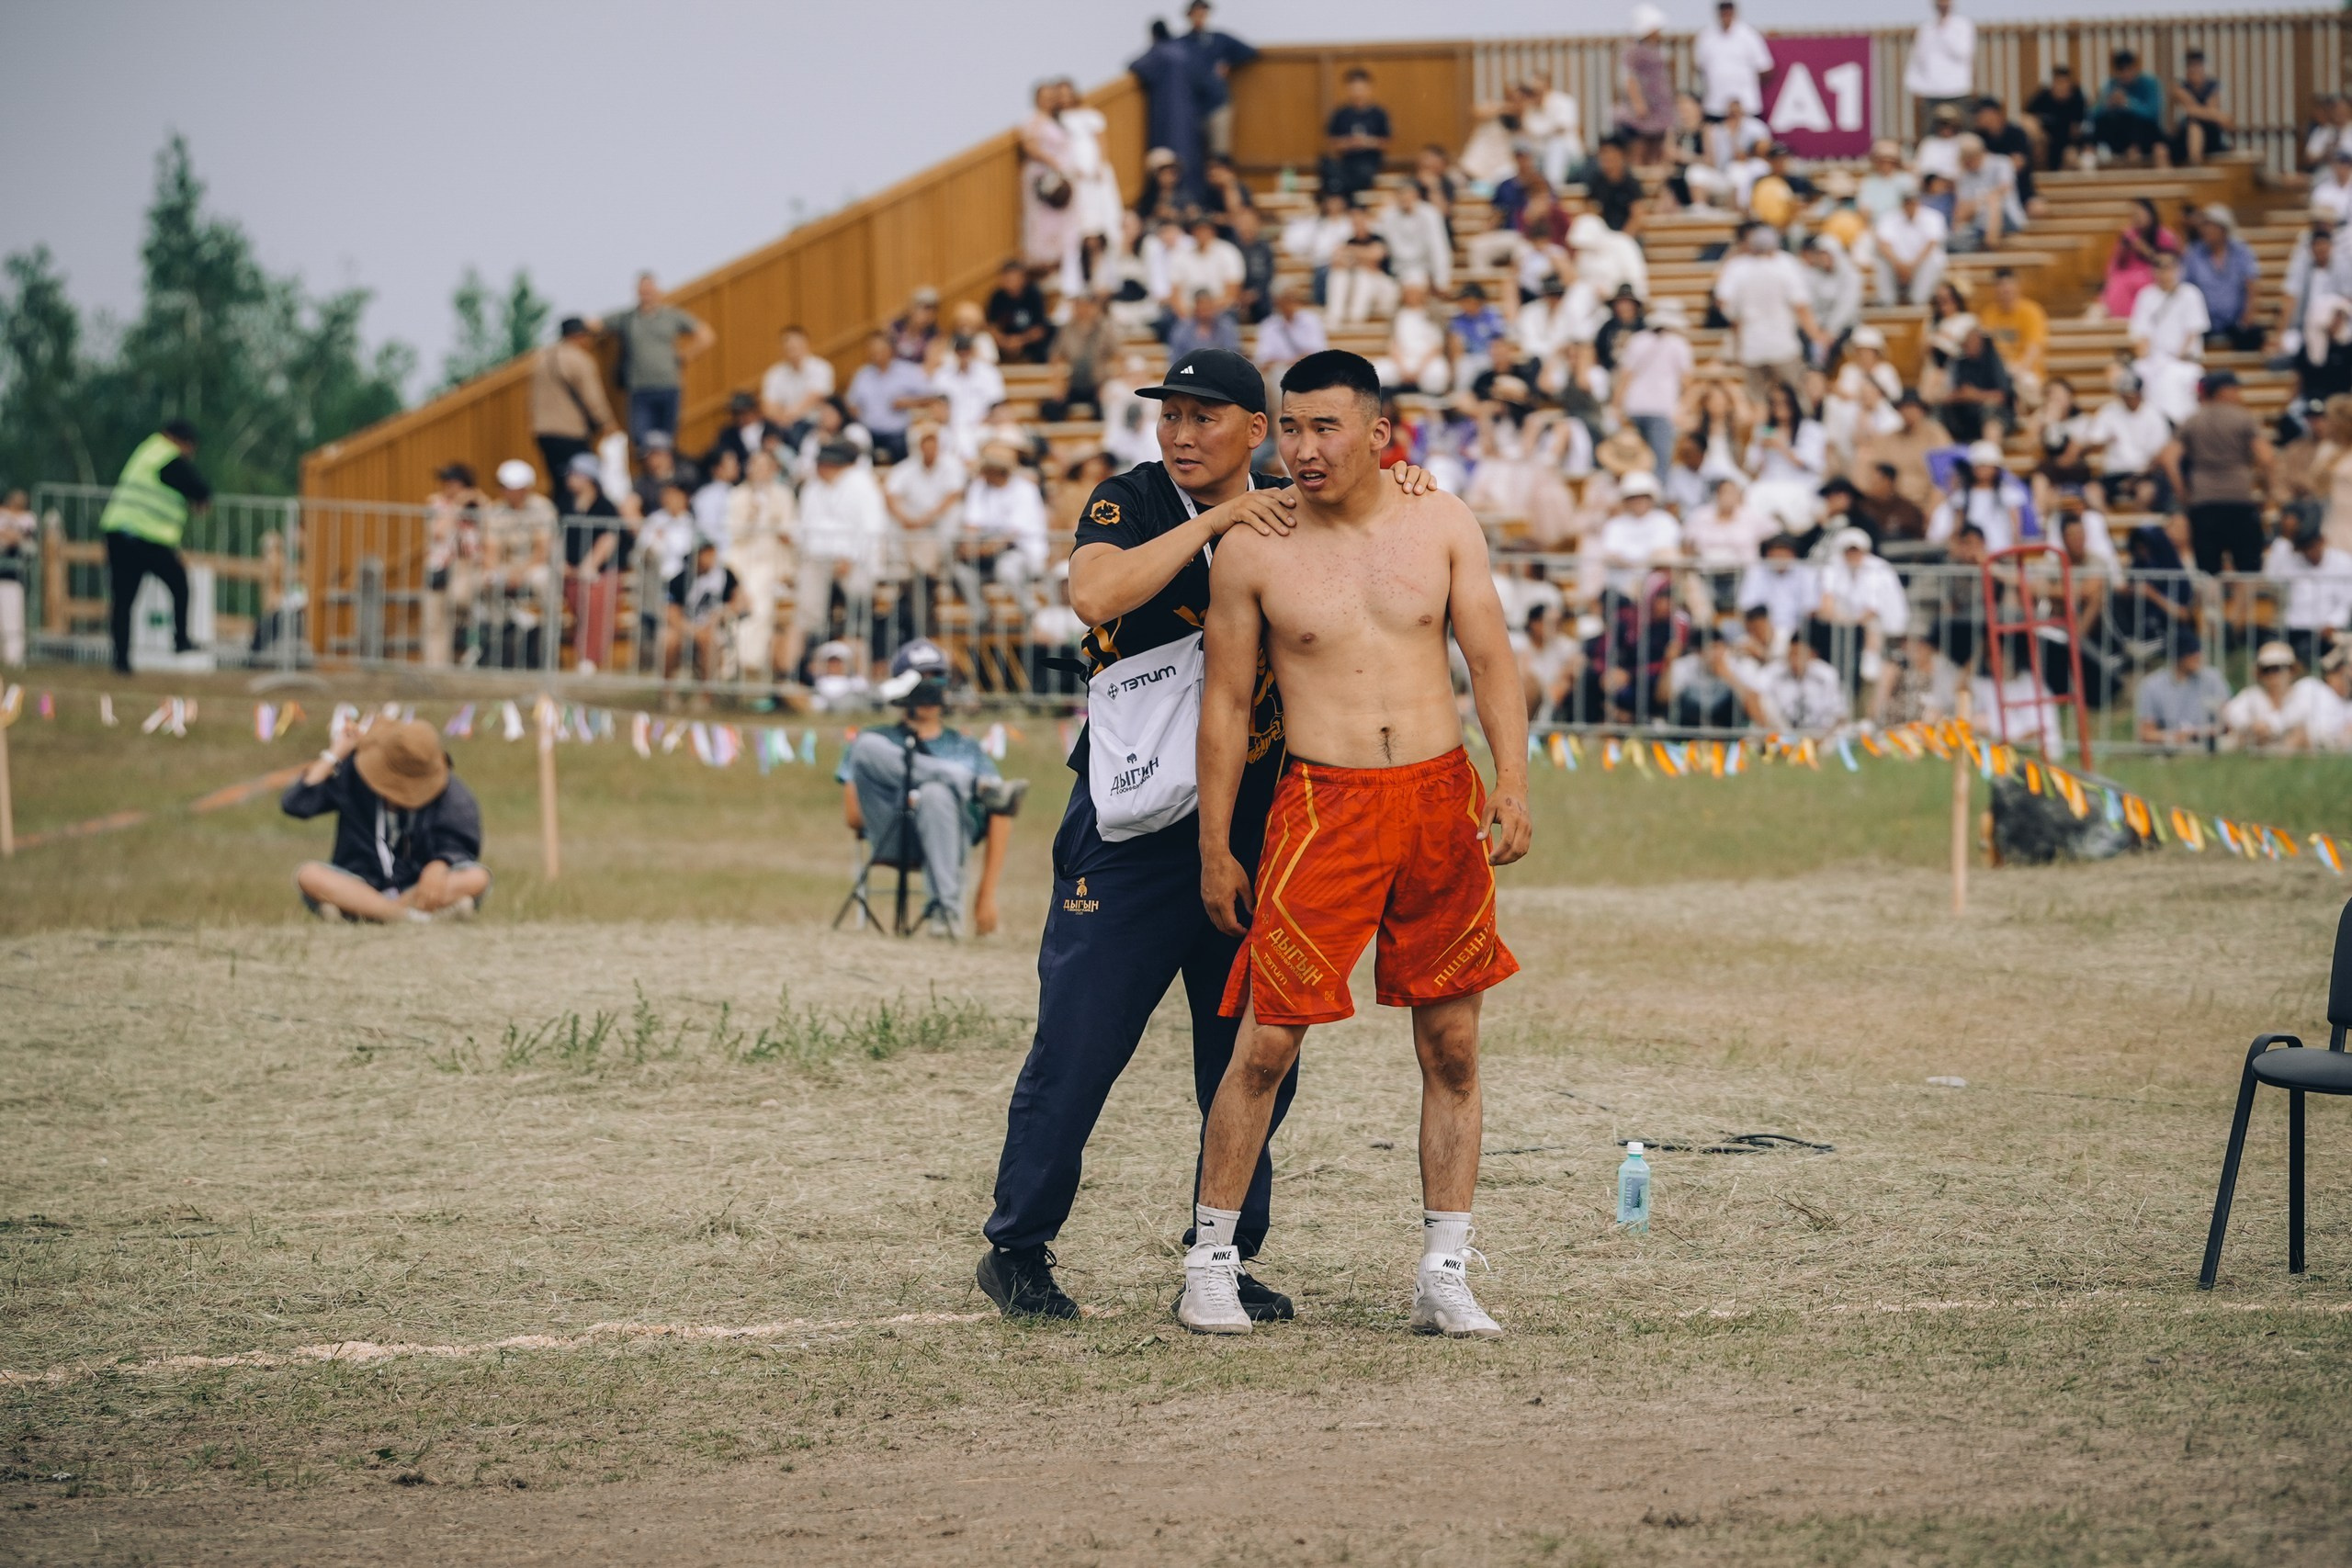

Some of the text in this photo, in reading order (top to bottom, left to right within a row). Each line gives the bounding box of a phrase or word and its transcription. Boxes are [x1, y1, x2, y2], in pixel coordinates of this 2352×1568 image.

[1769, 61, 1863, 133] A1
[1063, 899, 1100, 912] ДЫГЫН
[1265, 927, 1324, 987] ДЫГЫН
[1211, 1250, 1232, 1261] NIKE
[1442, 1258, 1462, 1270] NIKE
